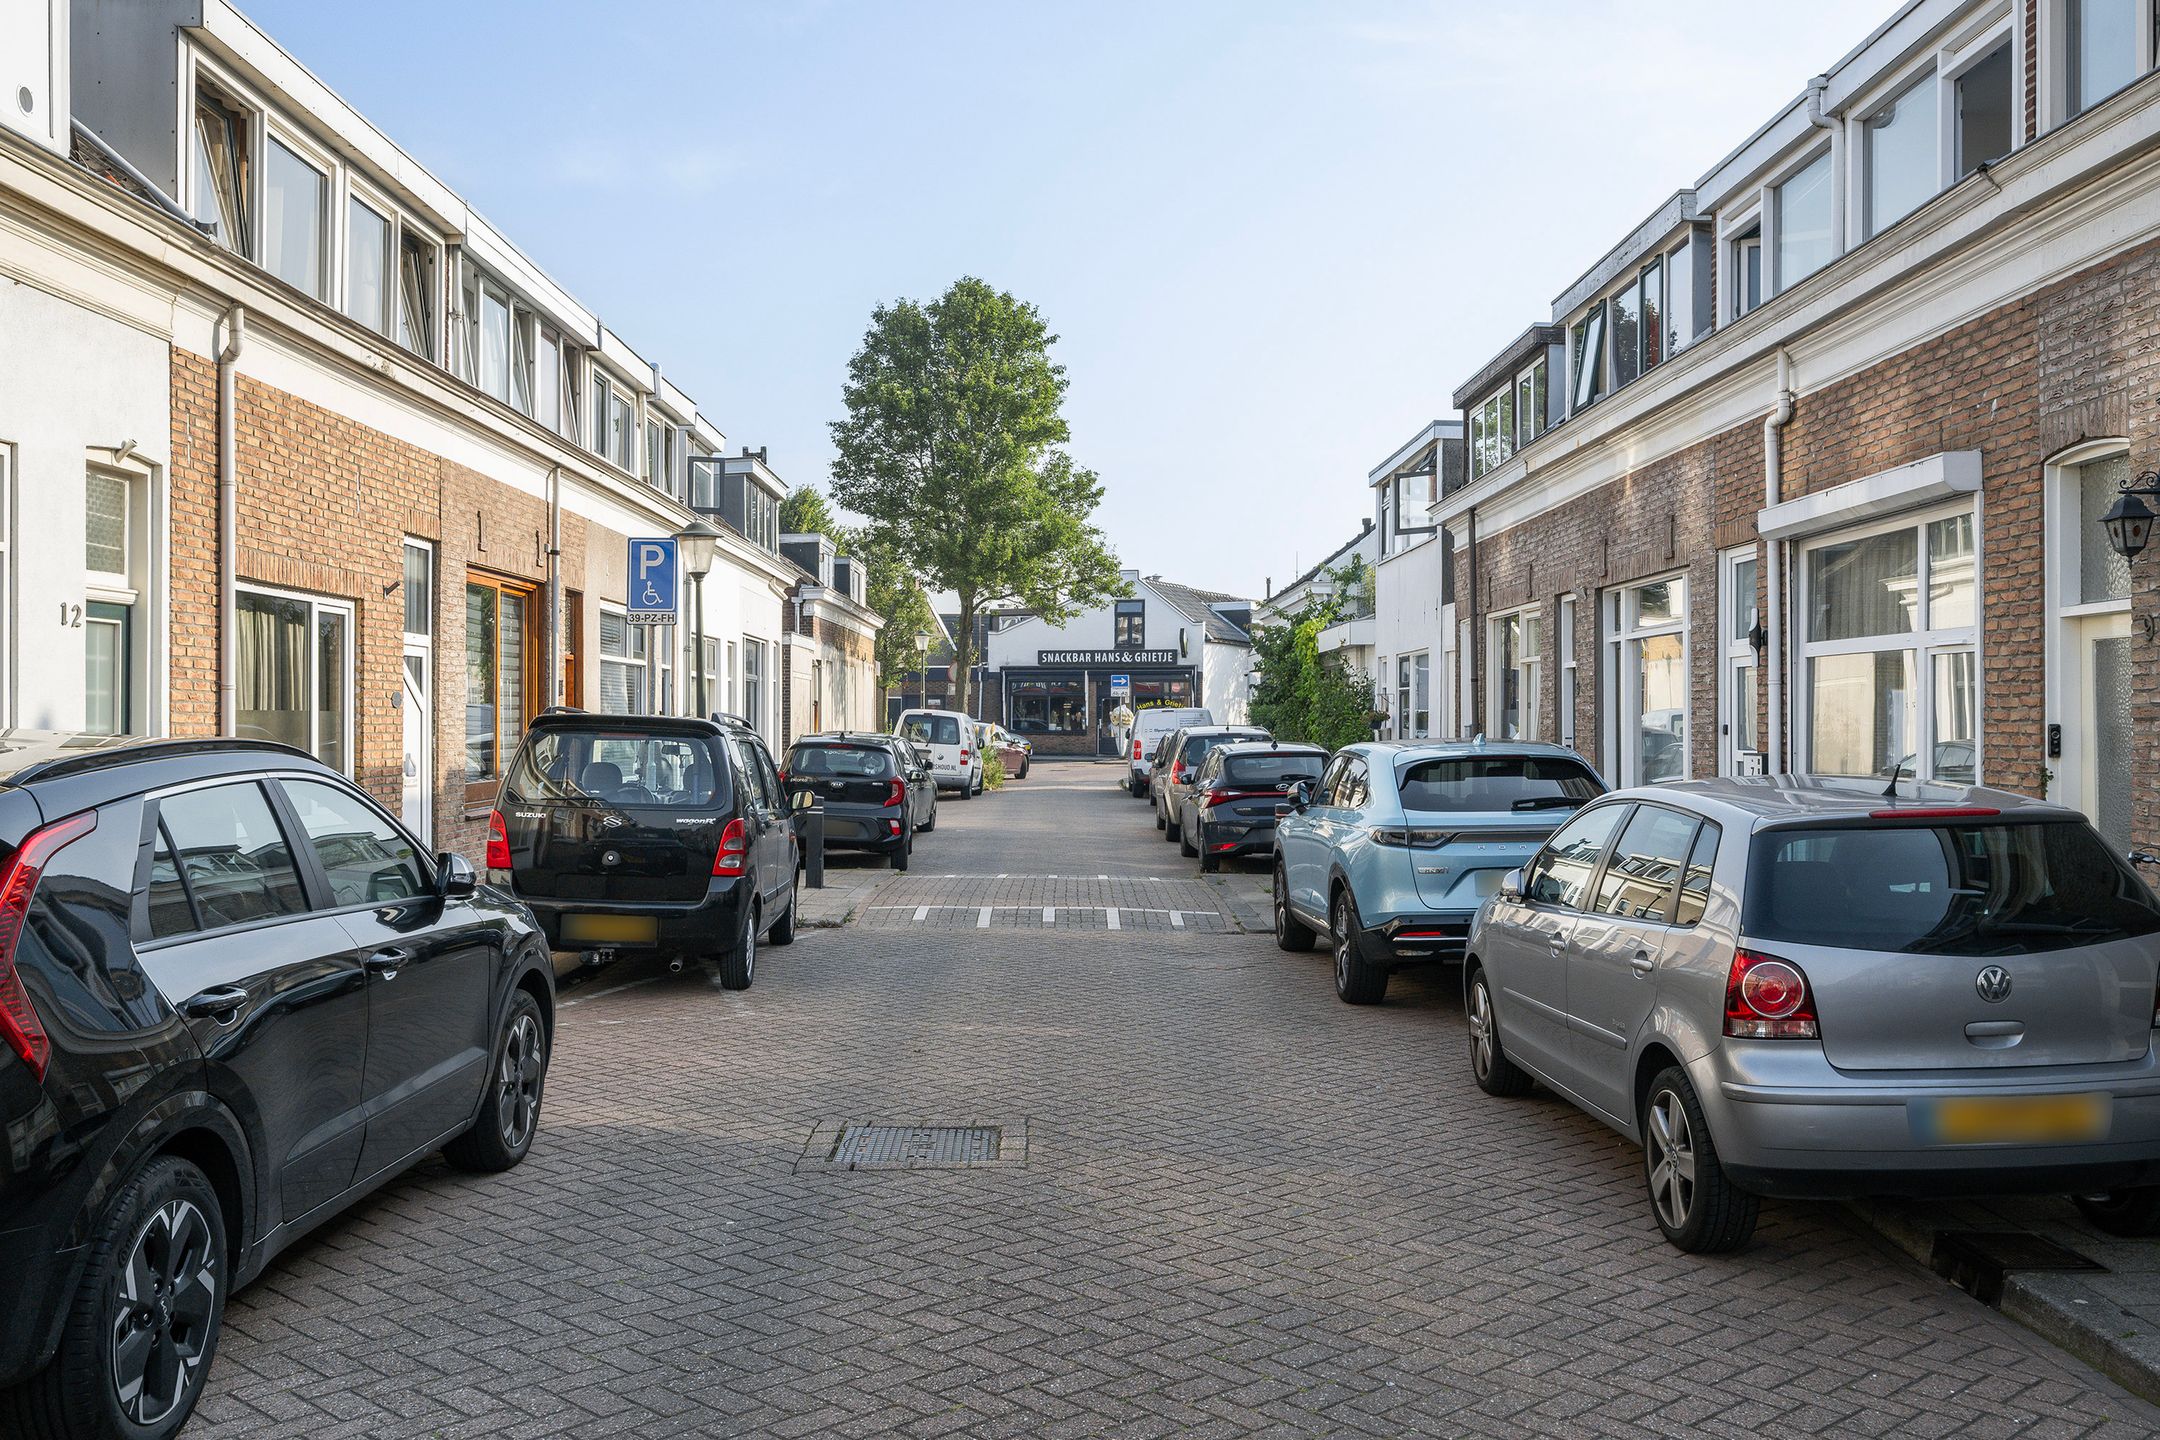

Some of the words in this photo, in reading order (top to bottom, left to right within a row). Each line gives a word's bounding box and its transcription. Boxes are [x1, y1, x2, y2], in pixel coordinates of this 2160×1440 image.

[640, 545, 665, 580] P
[60, 602, 82, 628] 12
[629, 613, 675, 623] 39-PZ-FH
[1042, 652, 1091, 663] SNACKBAR
[1094, 652, 1120, 663] HANS
[1121, 651, 1133, 663] &
[1134, 652, 1173, 663] GRIETJE
[1136, 701, 1154, 710] Hans
